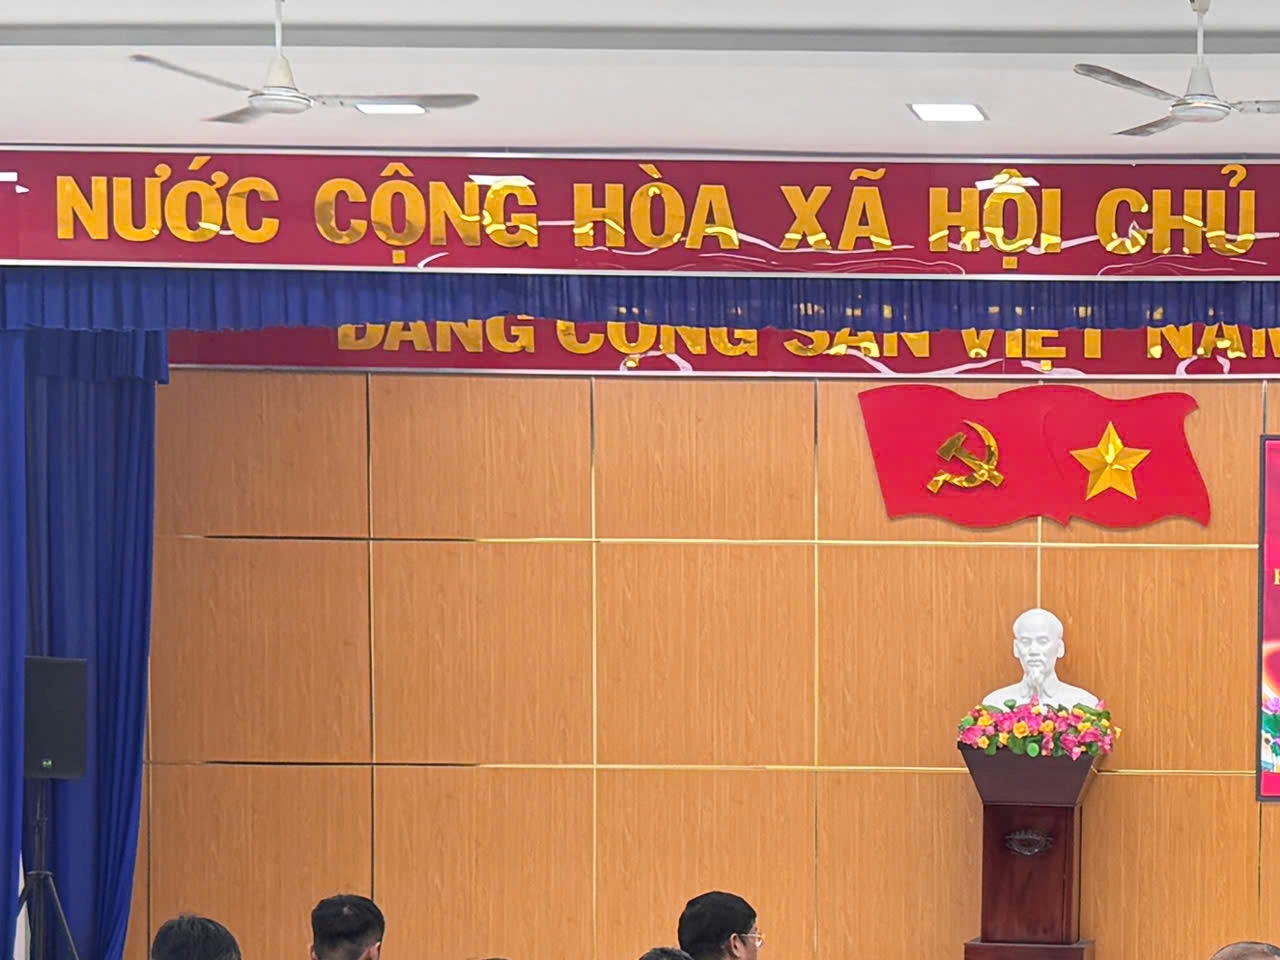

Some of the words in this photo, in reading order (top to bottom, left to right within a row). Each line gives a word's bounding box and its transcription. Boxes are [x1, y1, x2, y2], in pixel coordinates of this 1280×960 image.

[56, 156, 280, 244] NƯỚC
[315, 162, 540, 265] CỘNG
[573, 163, 740, 250] HÒA
[780, 168, 893, 252] XÃ
[928, 168, 1062, 269] HỘI
[1095, 164, 1256, 256] CHỦ
